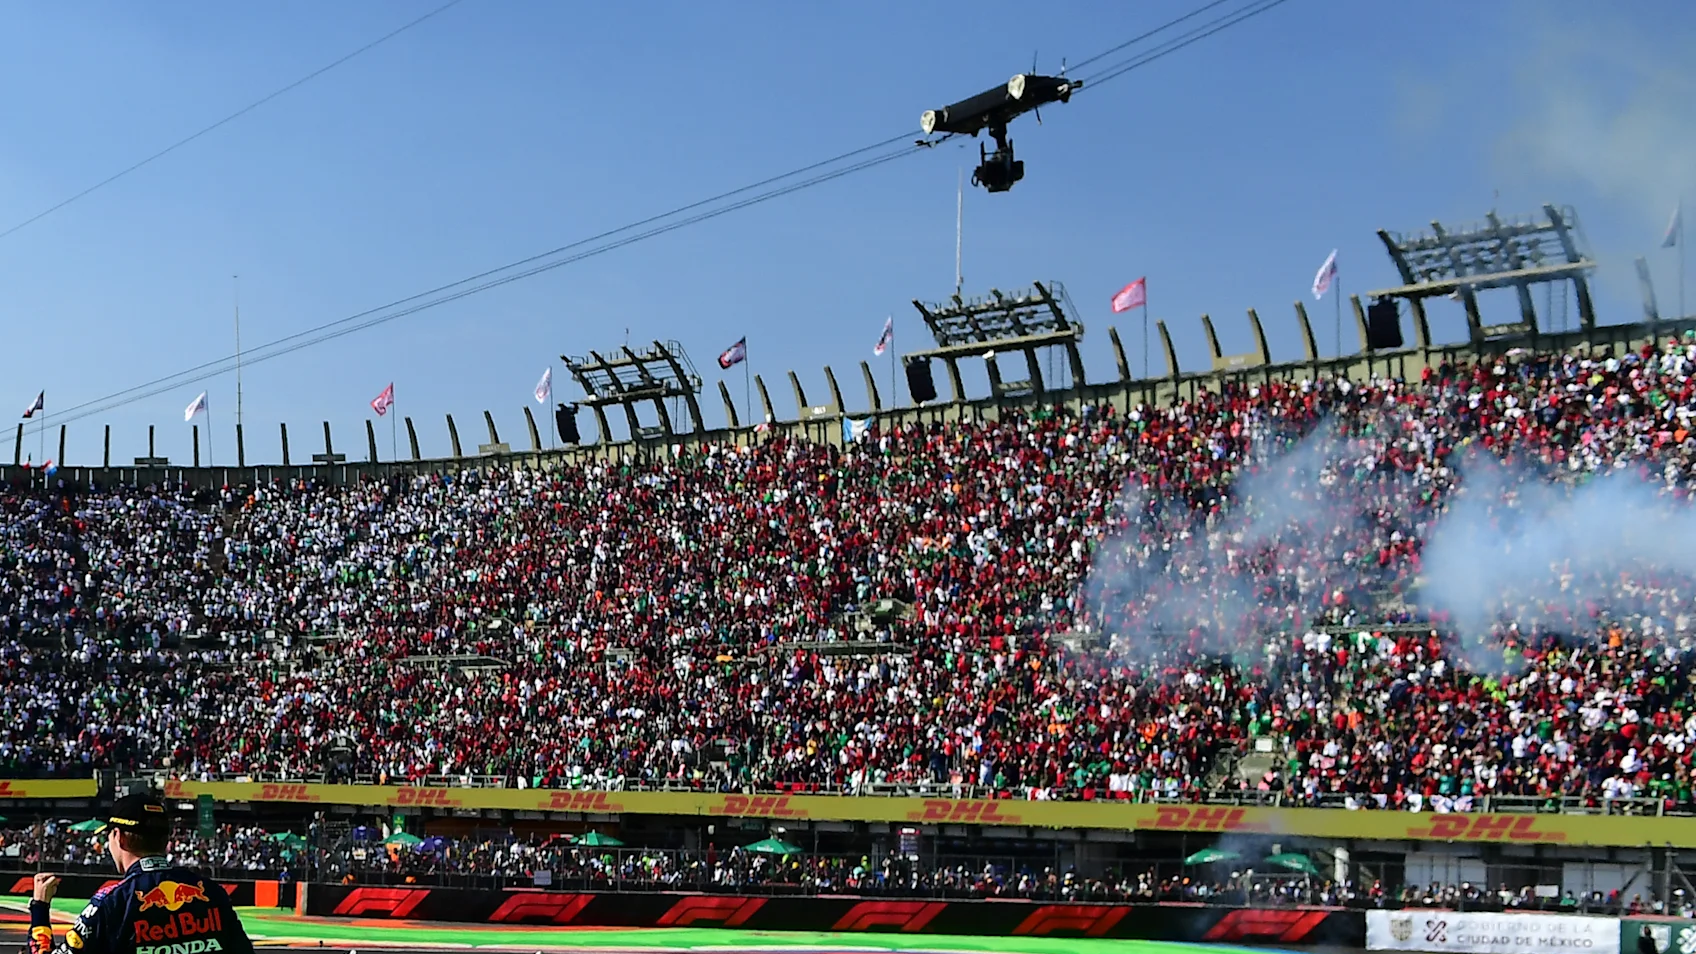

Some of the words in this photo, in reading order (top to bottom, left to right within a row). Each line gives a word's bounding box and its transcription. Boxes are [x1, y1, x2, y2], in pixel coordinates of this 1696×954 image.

[260, 784, 310, 801] DHL
[395, 787, 454, 806] DHL
[549, 791, 611, 810] DHL
[722, 795, 795, 817] DHL
[921, 800, 1007, 823] DHL
[1154, 806, 1247, 831] DHL
[1429, 815, 1542, 840] DHL
[134, 914, 176, 943] Red
[180, 908, 222, 936] Bull
[1457, 935, 1510, 946] CIUDAD
[1515, 936, 1531, 947] DE
[1538, 935, 1593, 948] MÉXICO
